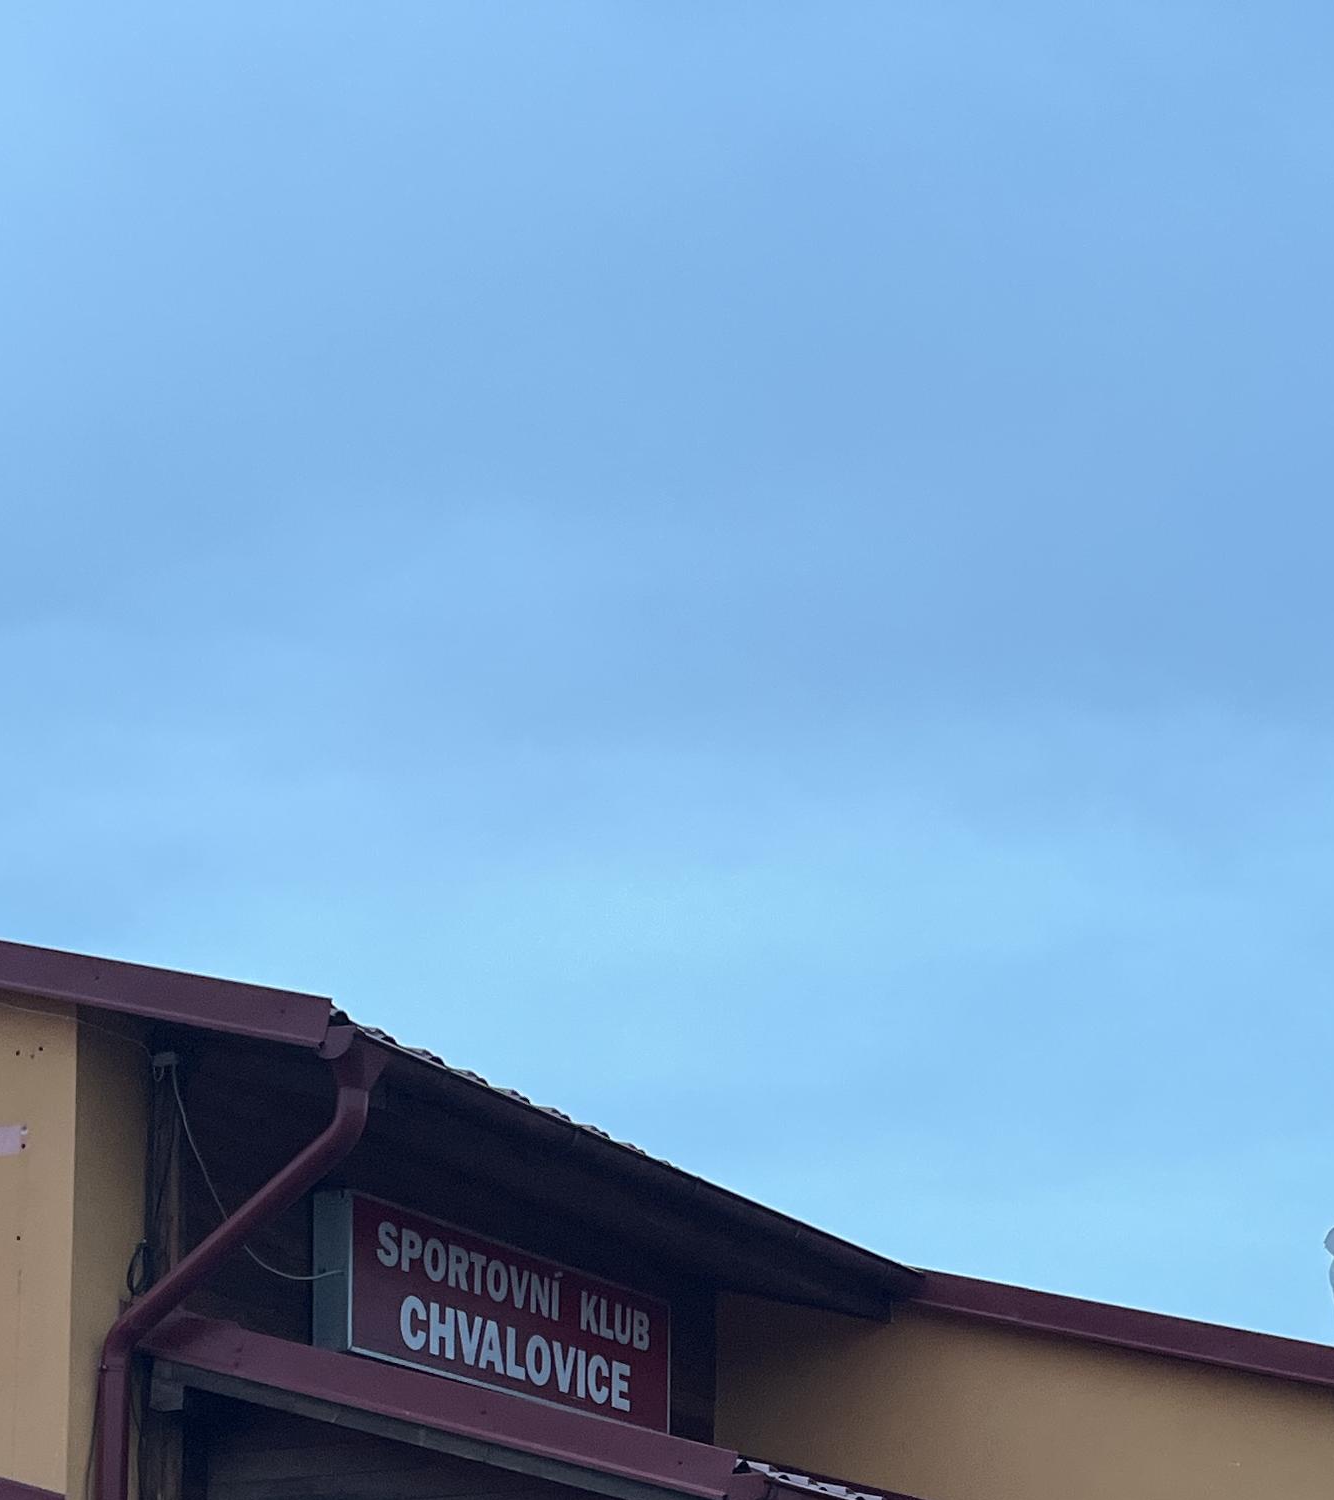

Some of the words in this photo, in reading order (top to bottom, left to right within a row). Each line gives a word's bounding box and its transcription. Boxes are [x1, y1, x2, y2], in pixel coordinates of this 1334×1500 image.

[375, 1220, 564, 1322] SPORTOVNÍ
[579, 1291, 651, 1352] KLUB
[399, 1295, 632, 1413] CHVALOVICE
